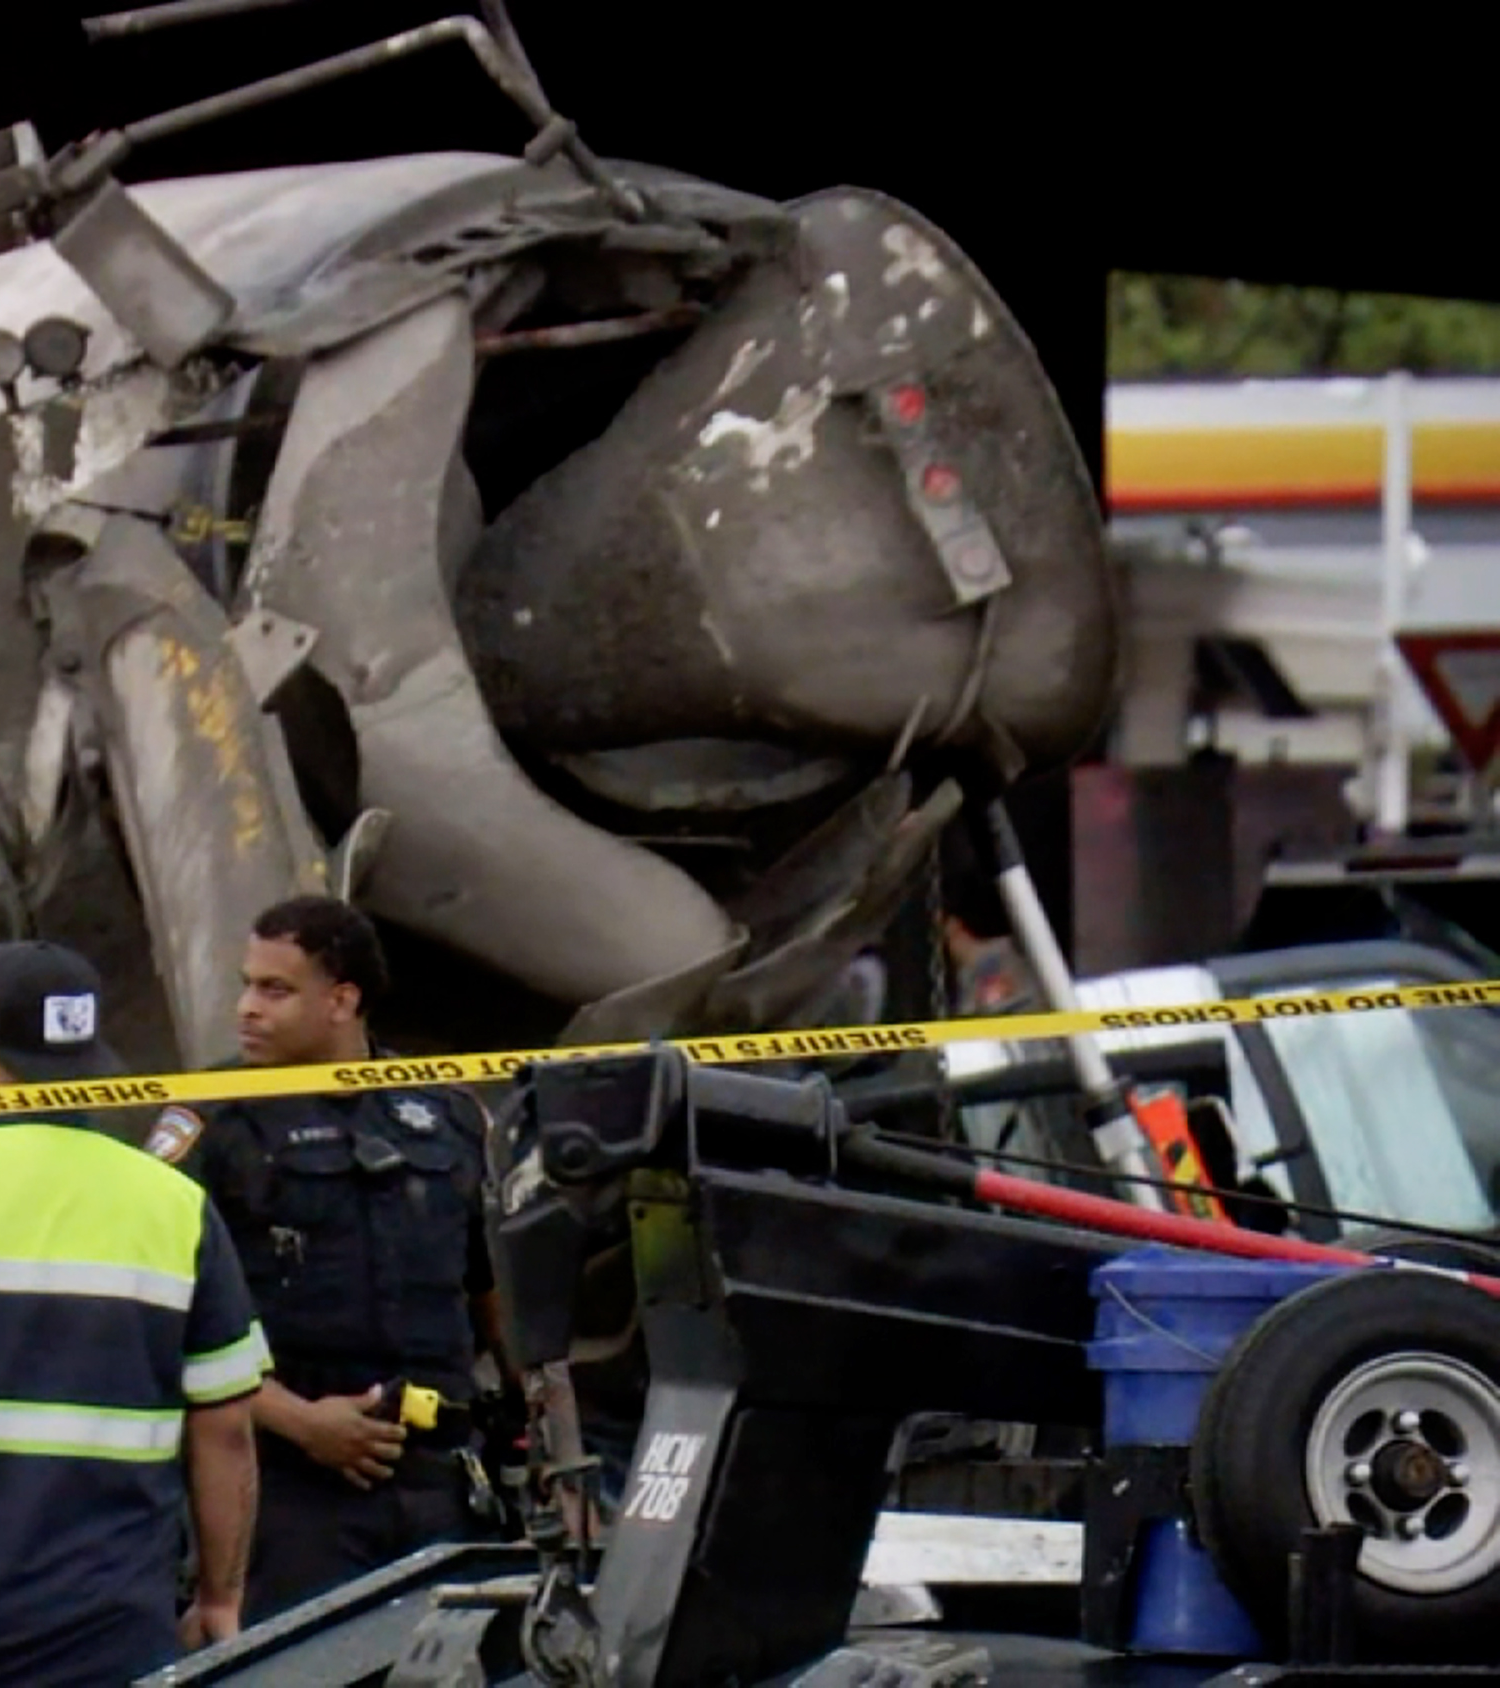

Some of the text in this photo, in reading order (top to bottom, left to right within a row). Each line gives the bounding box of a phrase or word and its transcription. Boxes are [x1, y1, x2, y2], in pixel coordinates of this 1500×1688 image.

[1256, 998, 1334, 1019] NOT
[1347, 993, 1401, 1009] DO
[1100, 1006, 1237, 1029] CROSS
[735, 1028, 926, 1059] SHERIFFS
[333, 1054, 549, 1086] OT CROSS
[638, 1431, 707, 1476] HCW
[624, 1473, 692, 1521] 708
